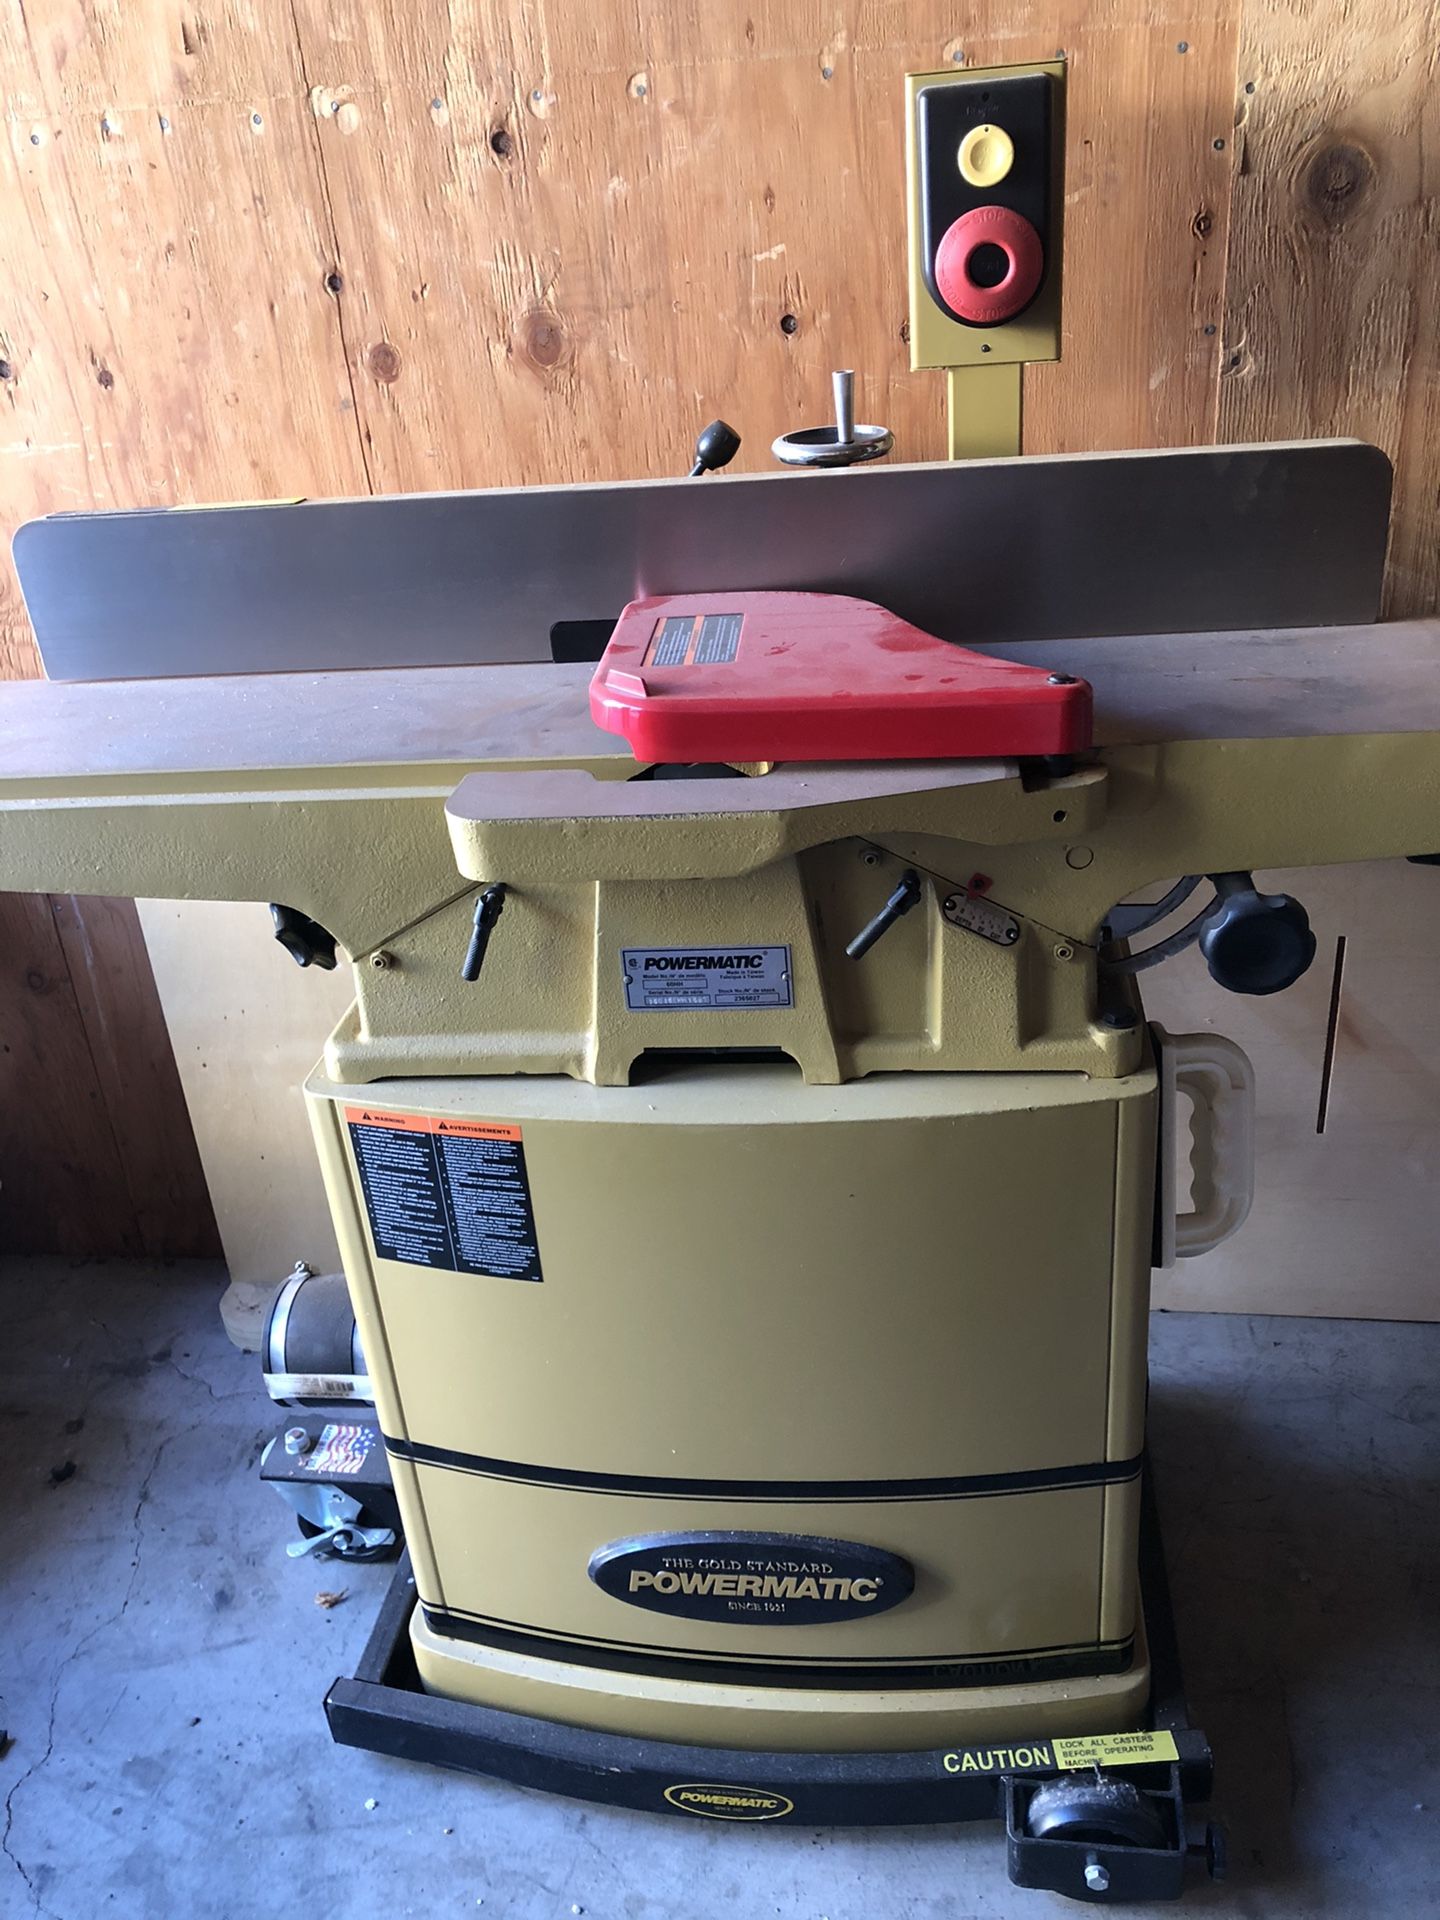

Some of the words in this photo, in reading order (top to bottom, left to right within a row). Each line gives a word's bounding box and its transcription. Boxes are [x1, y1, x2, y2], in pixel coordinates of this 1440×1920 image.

[972, 209, 1005, 224] STOP
[644, 954, 763, 971] POWERMATIC
[374, 1115, 406, 1125] WARNING
[449, 1125, 511, 1135] AVERTISSEMENTS
[662, 1558, 695, 1569] THE
[698, 1558, 742, 1571] GOLD
[747, 1560, 833, 1574] STANDARD
[629, 1569, 879, 1602] POWERMATIC
[728, 1601, 762, 1611] SINCE
[1060, 1740, 1085, 1749] LOCK
[1090, 1738, 1107, 1746] ALL
[1113, 1735, 1154, 1745] CASTERS
[1062, 1748, 1098, 1758] BEFORE
[1104, 1744, 1154, 1755] OPERATING
[943, 1747, 1050, 1773] CAUTION
[680, 1791, 778, 1809] POWERMATIC
